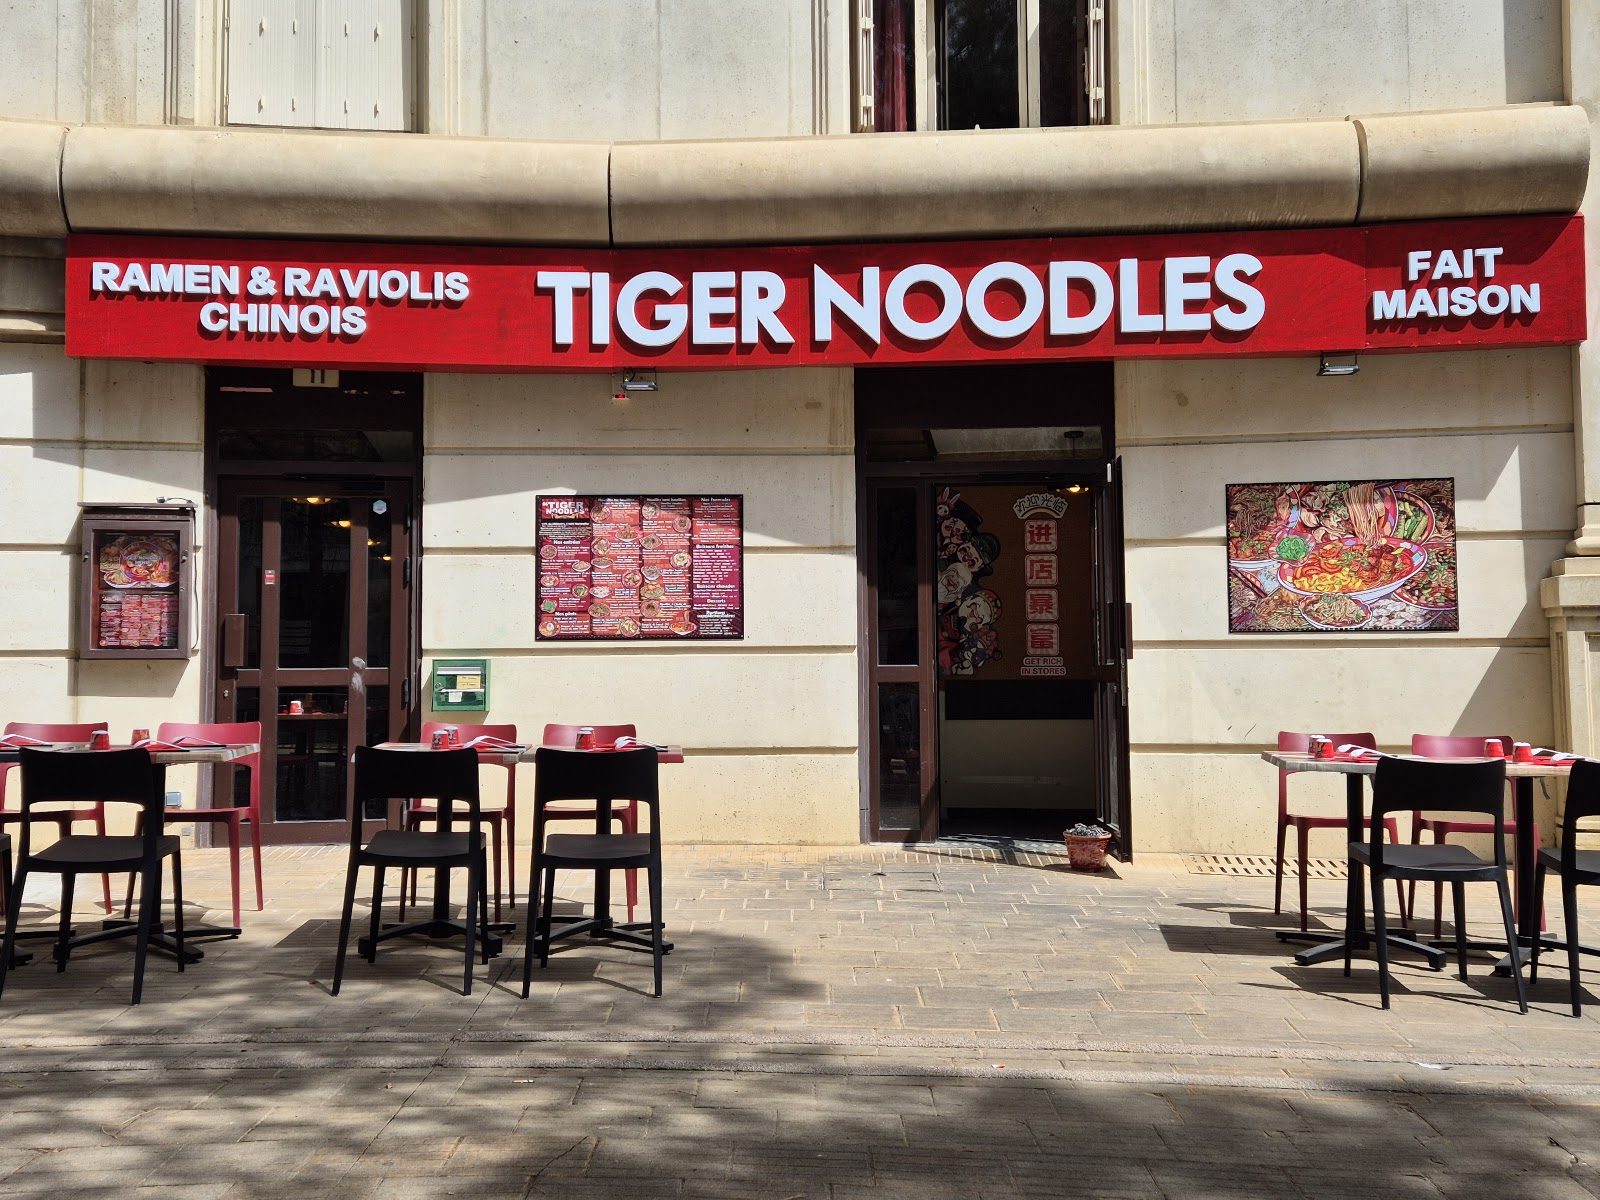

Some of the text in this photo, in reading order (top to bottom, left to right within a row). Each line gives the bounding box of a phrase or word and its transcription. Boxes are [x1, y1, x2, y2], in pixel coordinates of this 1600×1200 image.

[91, 261, 470, 302] RAMEN & RAVIOLIS
[1408, 247, 1504, 282] FAIT
[537, 253, 1266, 347] TIGER NOODLES
[1372, 283, 1542, 321] MAISON
[199, 302, 367, 337] CHINOIS
[1014, 494, 1067, 514] 欢迎光临
[1028, 523, 1054, 650] 进店暴富
[1021, 667, 1065, 675] IN STORES
[1024, 657, 1062, 665] GET RICH
